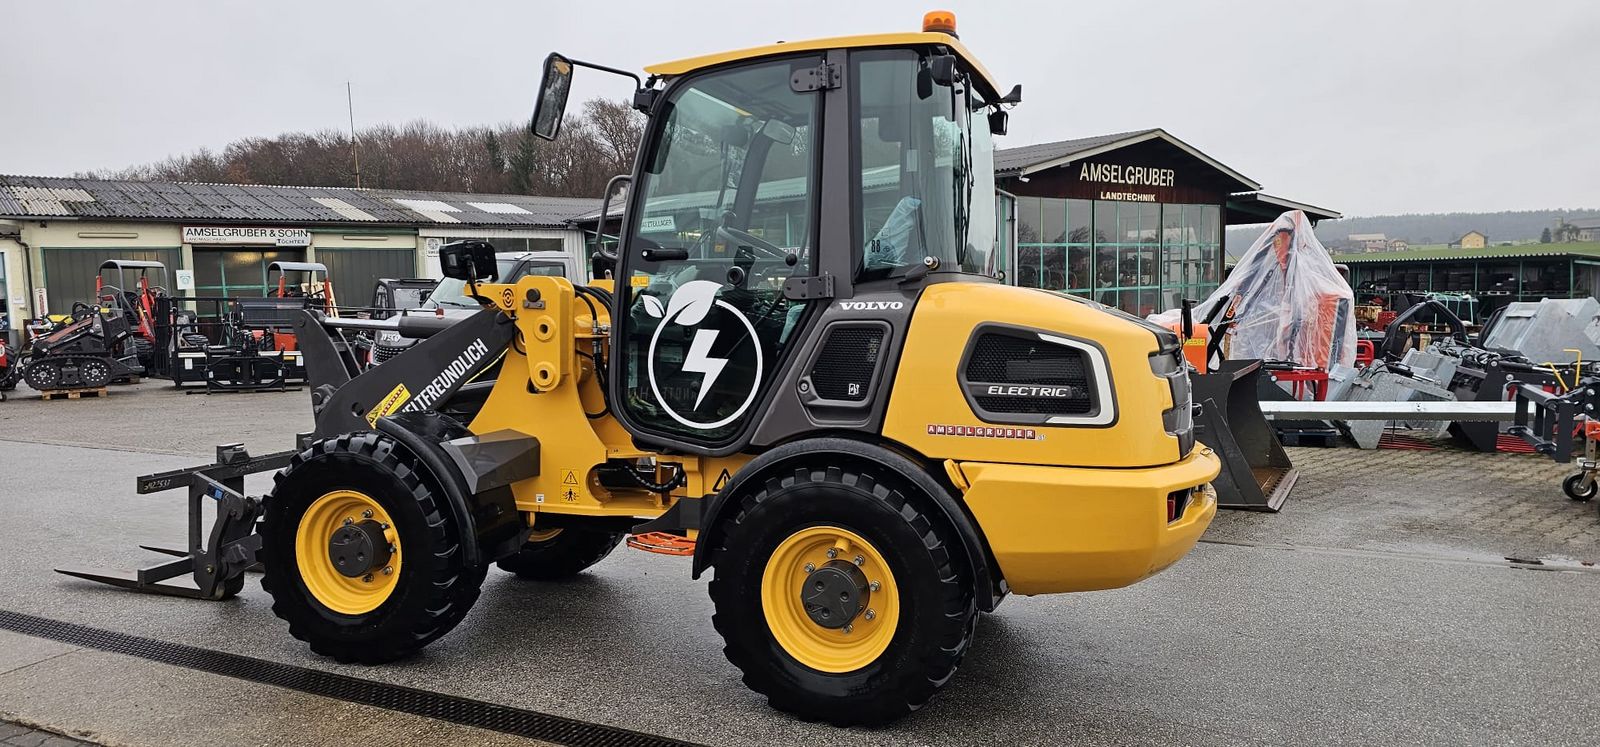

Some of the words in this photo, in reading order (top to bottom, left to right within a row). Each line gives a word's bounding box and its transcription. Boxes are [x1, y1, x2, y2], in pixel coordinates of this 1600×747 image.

[1079, 162, 1175, 187] AMSELGRUBER
[1100, 191, 1156, 202] LANDTECHNIK
[186, 228, 267, 238] AMSELGRUBER
[269, 229, 276, 238] &
[278, 229, 308, 238] SOHN
[839, 301, 904, 311] VOLVO
[401, 337, 489, 413] ELTFREUNDLICH
[987, 385, 1068, 397] ELECTRIC
